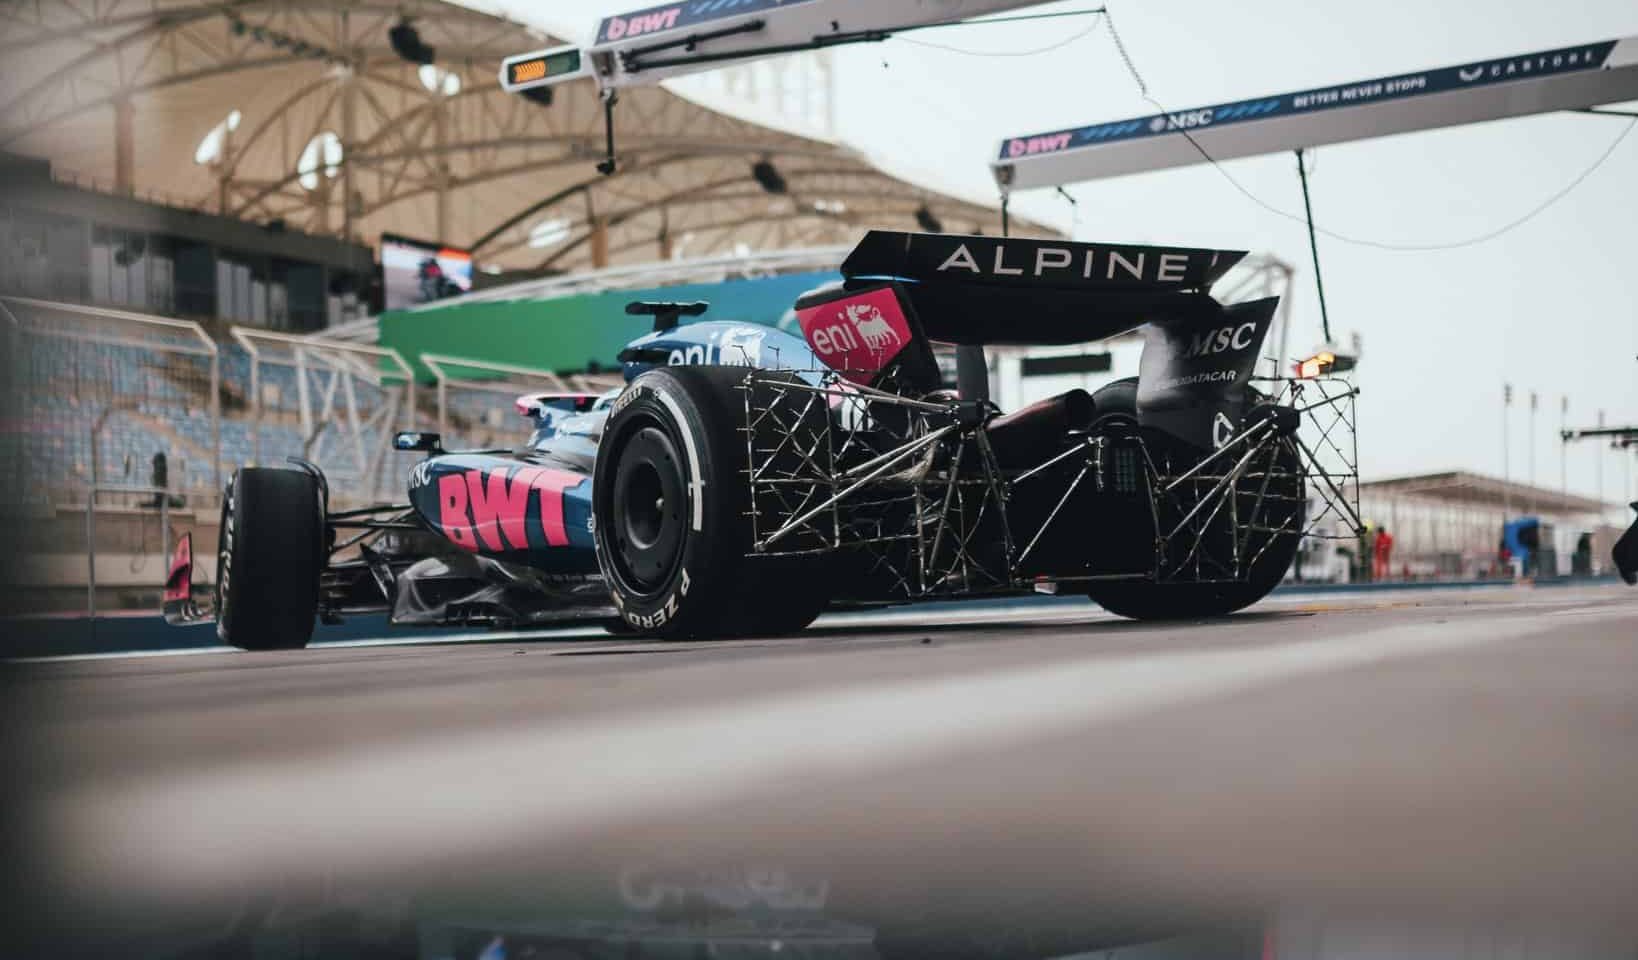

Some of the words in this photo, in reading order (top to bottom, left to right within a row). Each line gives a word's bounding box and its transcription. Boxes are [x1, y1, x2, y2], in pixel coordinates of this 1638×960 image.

[627, 8, 681, 36] BWT
[1293, 89, 1339, 108] BETTER
[1342, 83, 1384, 100] NEVER
[1386, 76, 1427, 94] STOPS
[1166, 108, 1213, 131] MSC
[1028, 132, 1073, 155] BWT
[936, 243, 1190, 282] ALPINE
[812, 312, 858, 355] eni
[438, 467, 587, 553] BWT
[628, 593, 679, 629] ZERO
